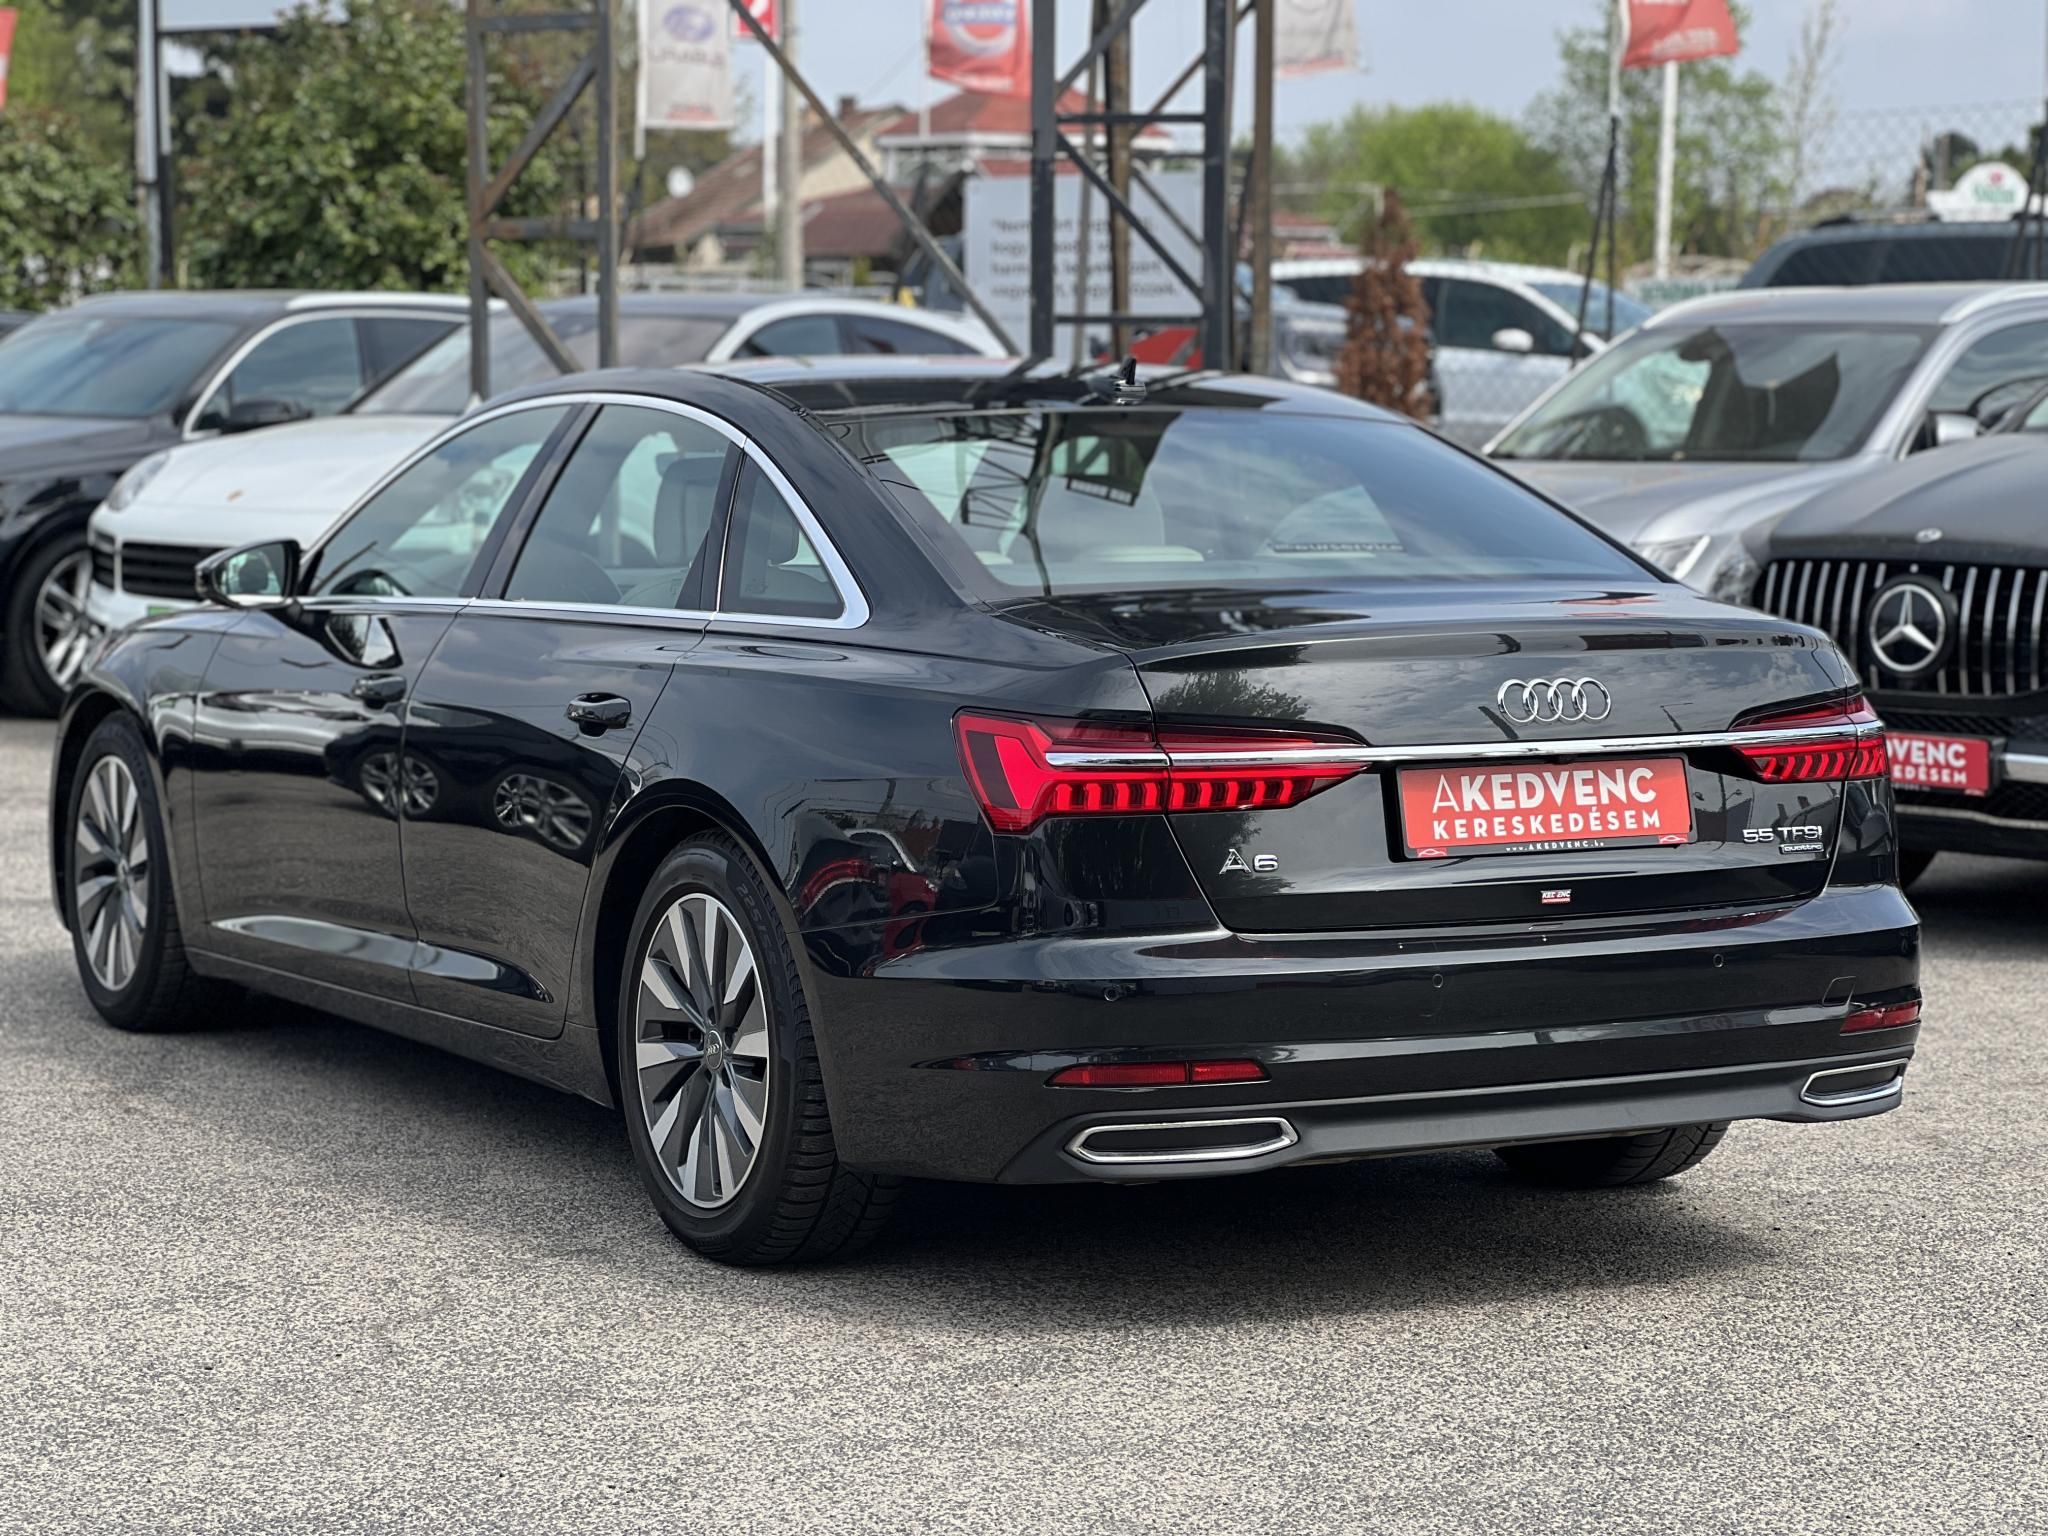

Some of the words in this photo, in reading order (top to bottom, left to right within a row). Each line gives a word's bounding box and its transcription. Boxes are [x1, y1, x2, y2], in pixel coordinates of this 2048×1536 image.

[1432, 804, 1661, 840] KERESKEDÉSEM
[1742, 828, 1775, 844] 55
[1777, 825, 1823, 841] TFSI
[1783, 844, 1823, 853] quattro
[1219, 848, 1279, 875] A6
